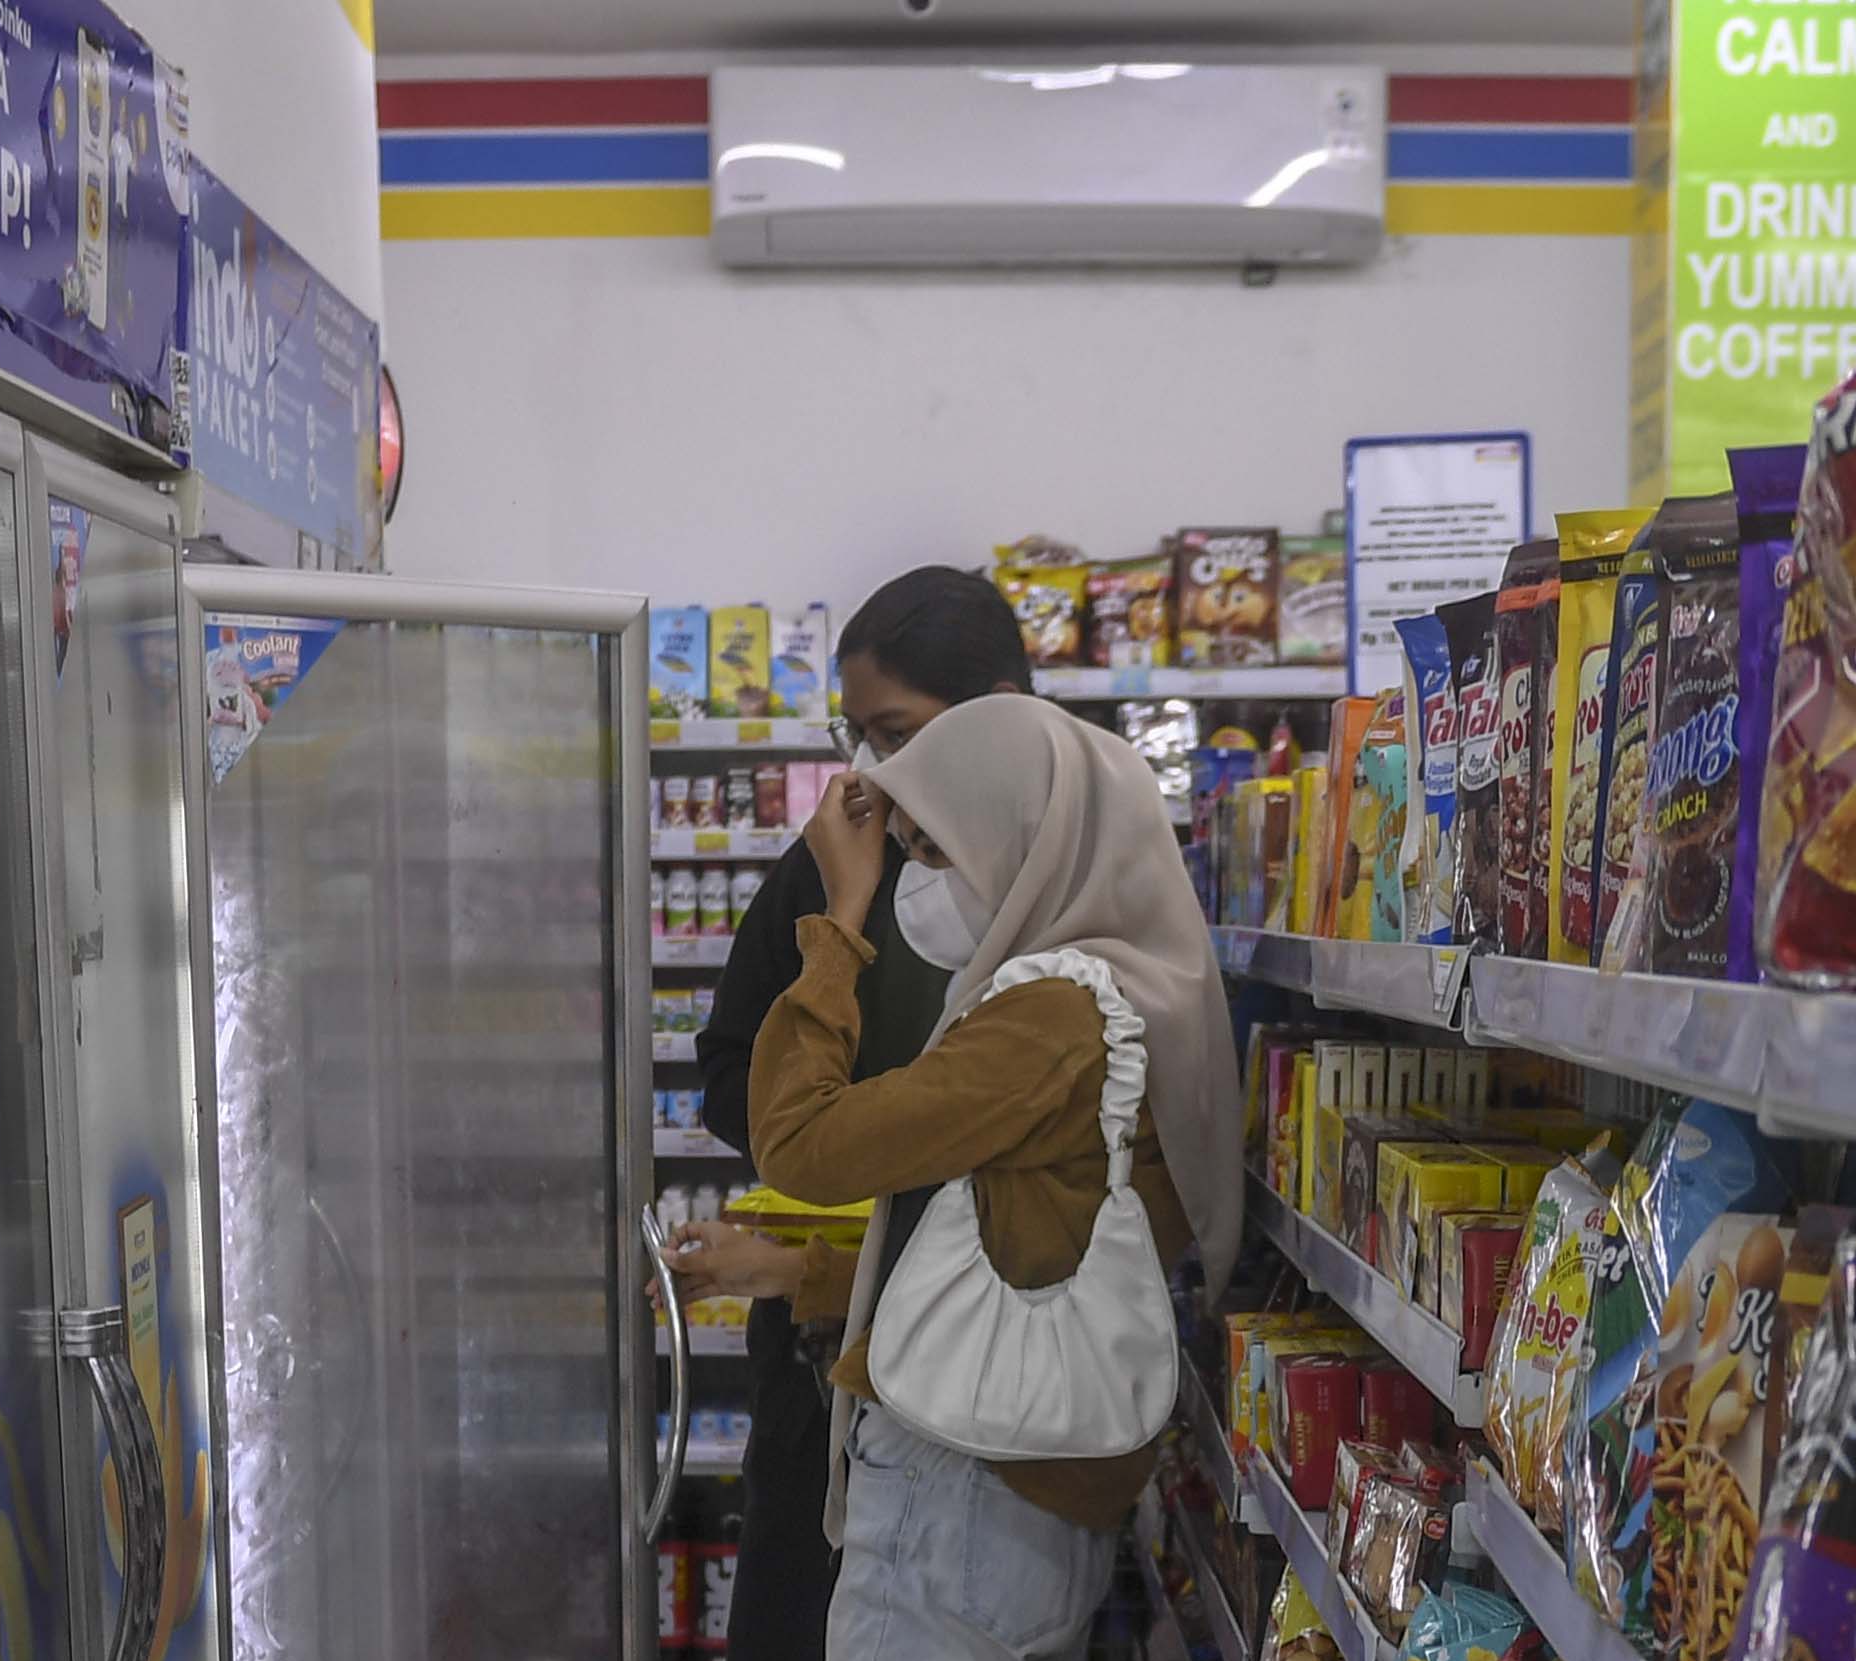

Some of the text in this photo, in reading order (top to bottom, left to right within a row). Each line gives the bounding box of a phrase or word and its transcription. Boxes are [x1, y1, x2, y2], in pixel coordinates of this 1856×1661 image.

[1762, 113, 1837, 147] AND
[196, 357, 262, 463] PAKET
[1655, 790, 1709, 835] CRUNCH
